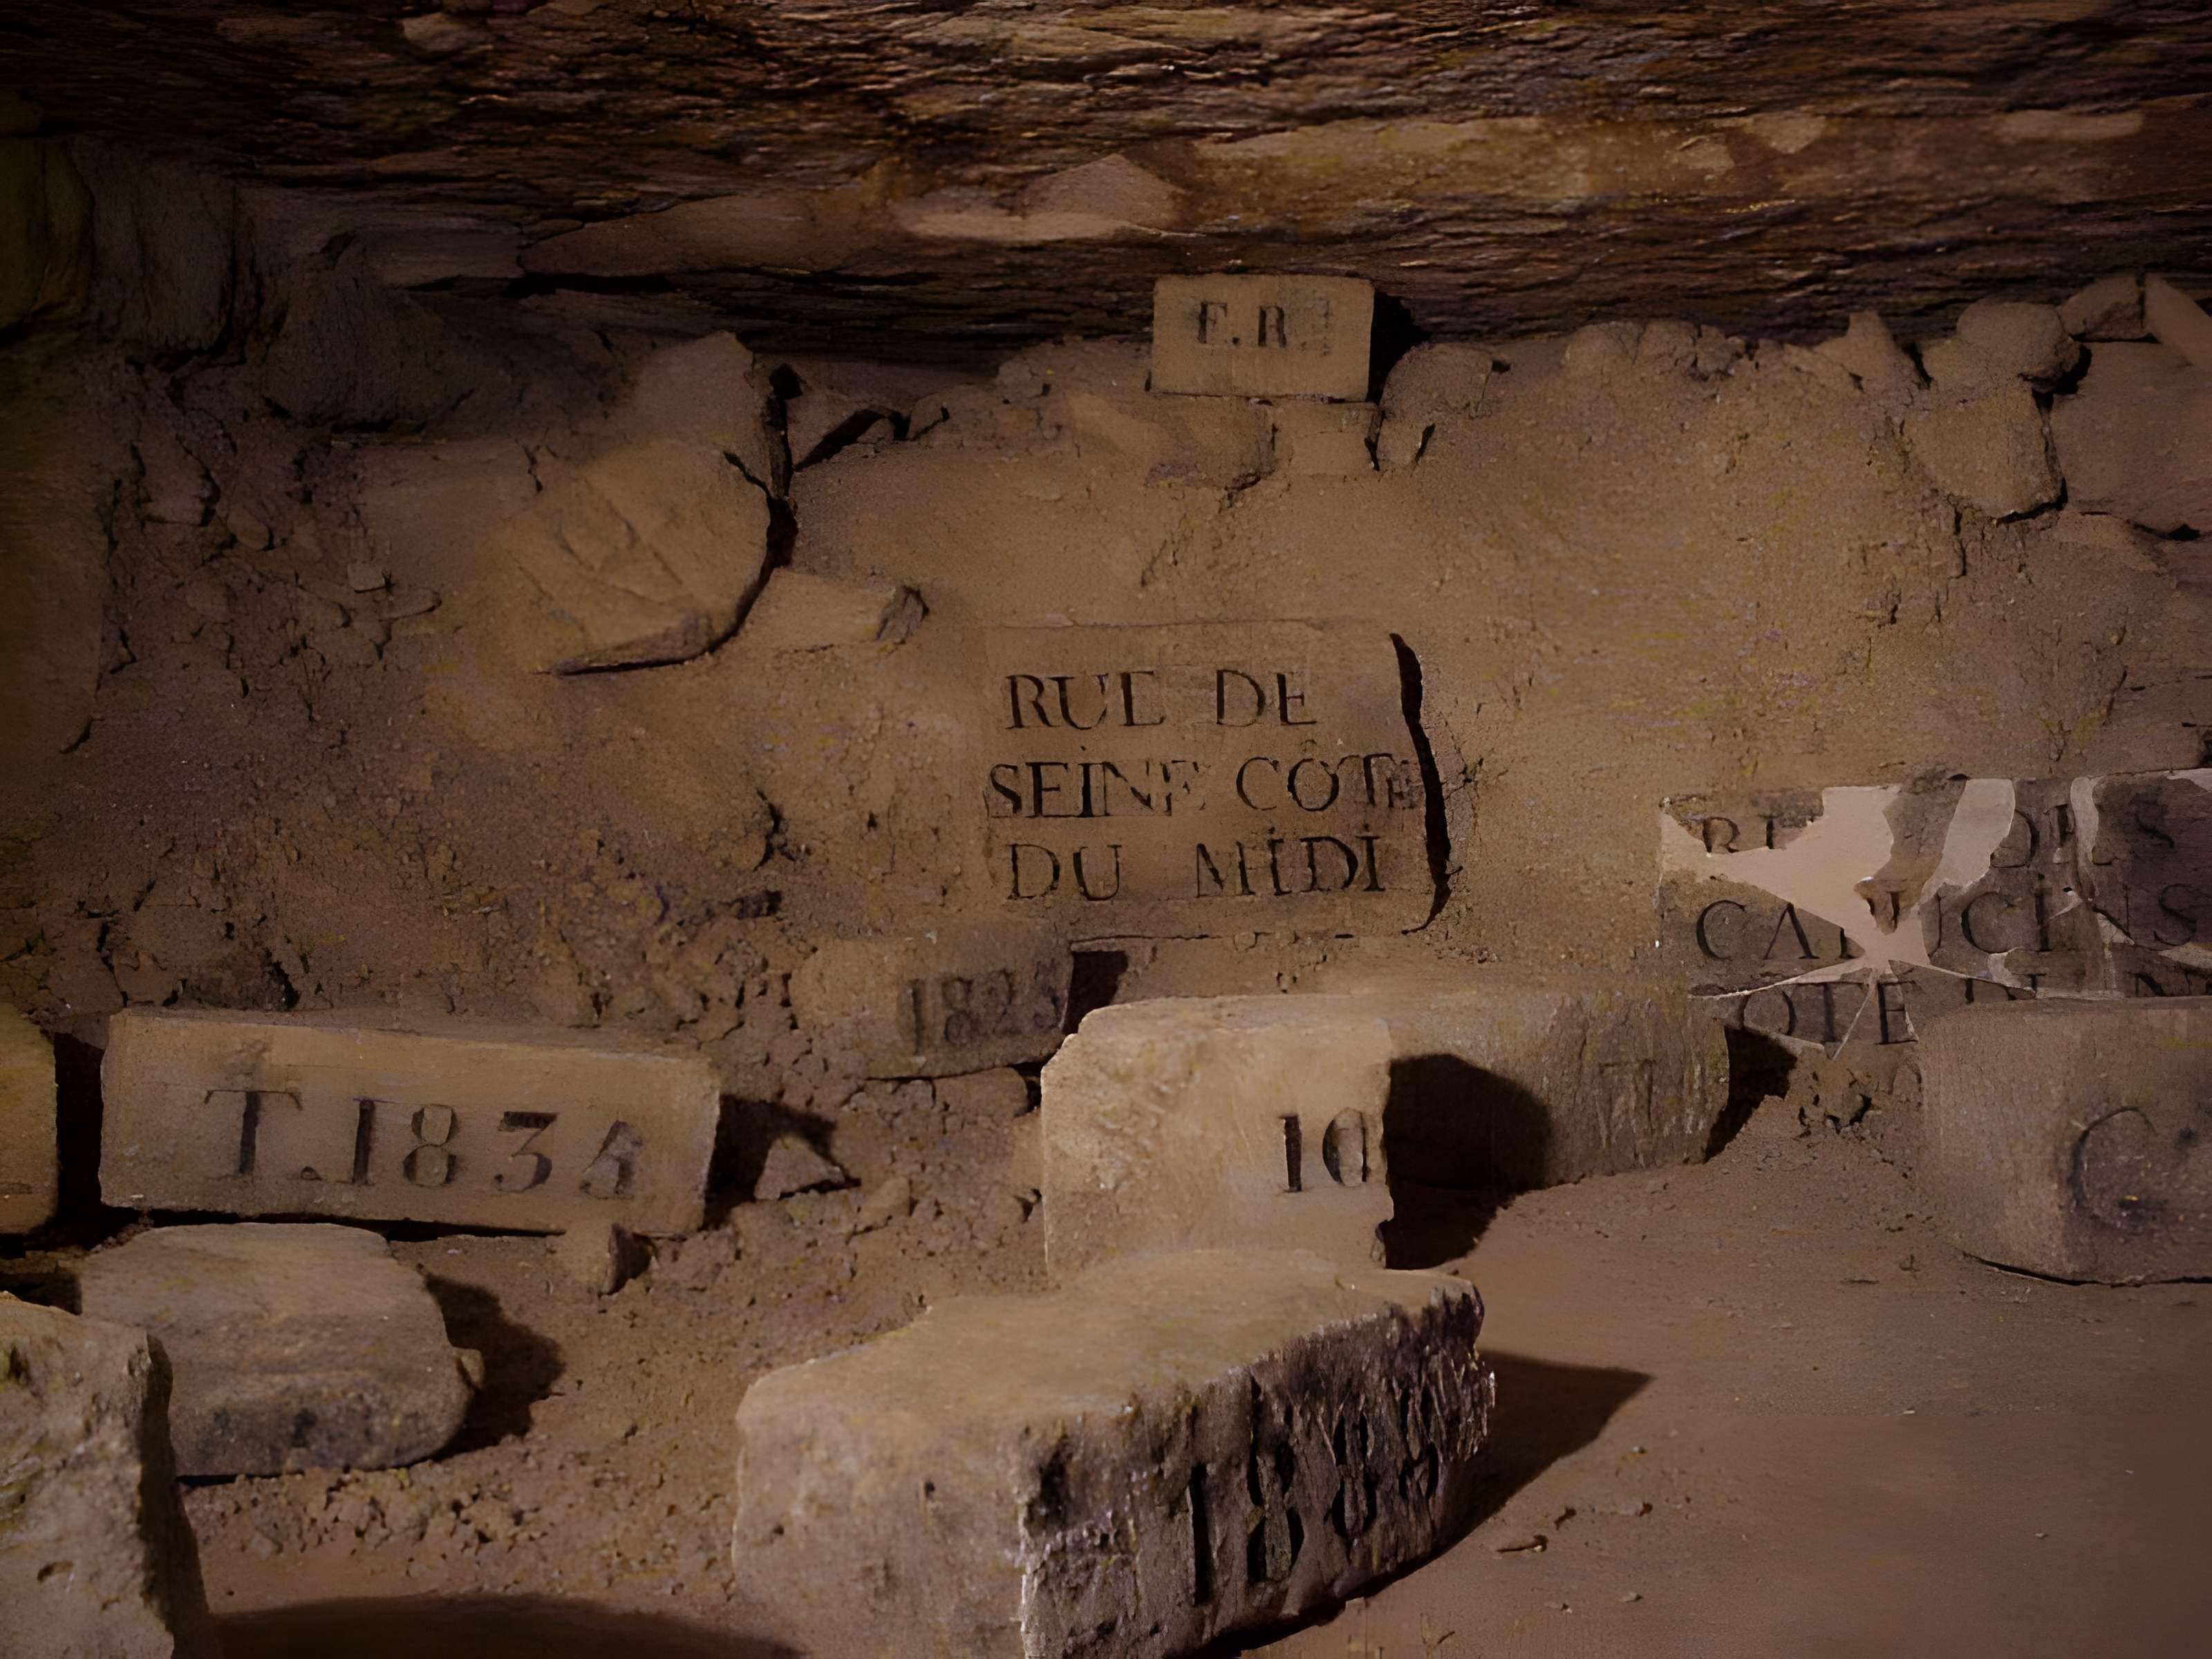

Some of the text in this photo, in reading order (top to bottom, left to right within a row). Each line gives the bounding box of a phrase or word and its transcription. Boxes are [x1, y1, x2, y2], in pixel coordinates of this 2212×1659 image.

[1005, 668, 1319, 730] RUE DE
[1005, 827, 1387, 901] DU MIDI
